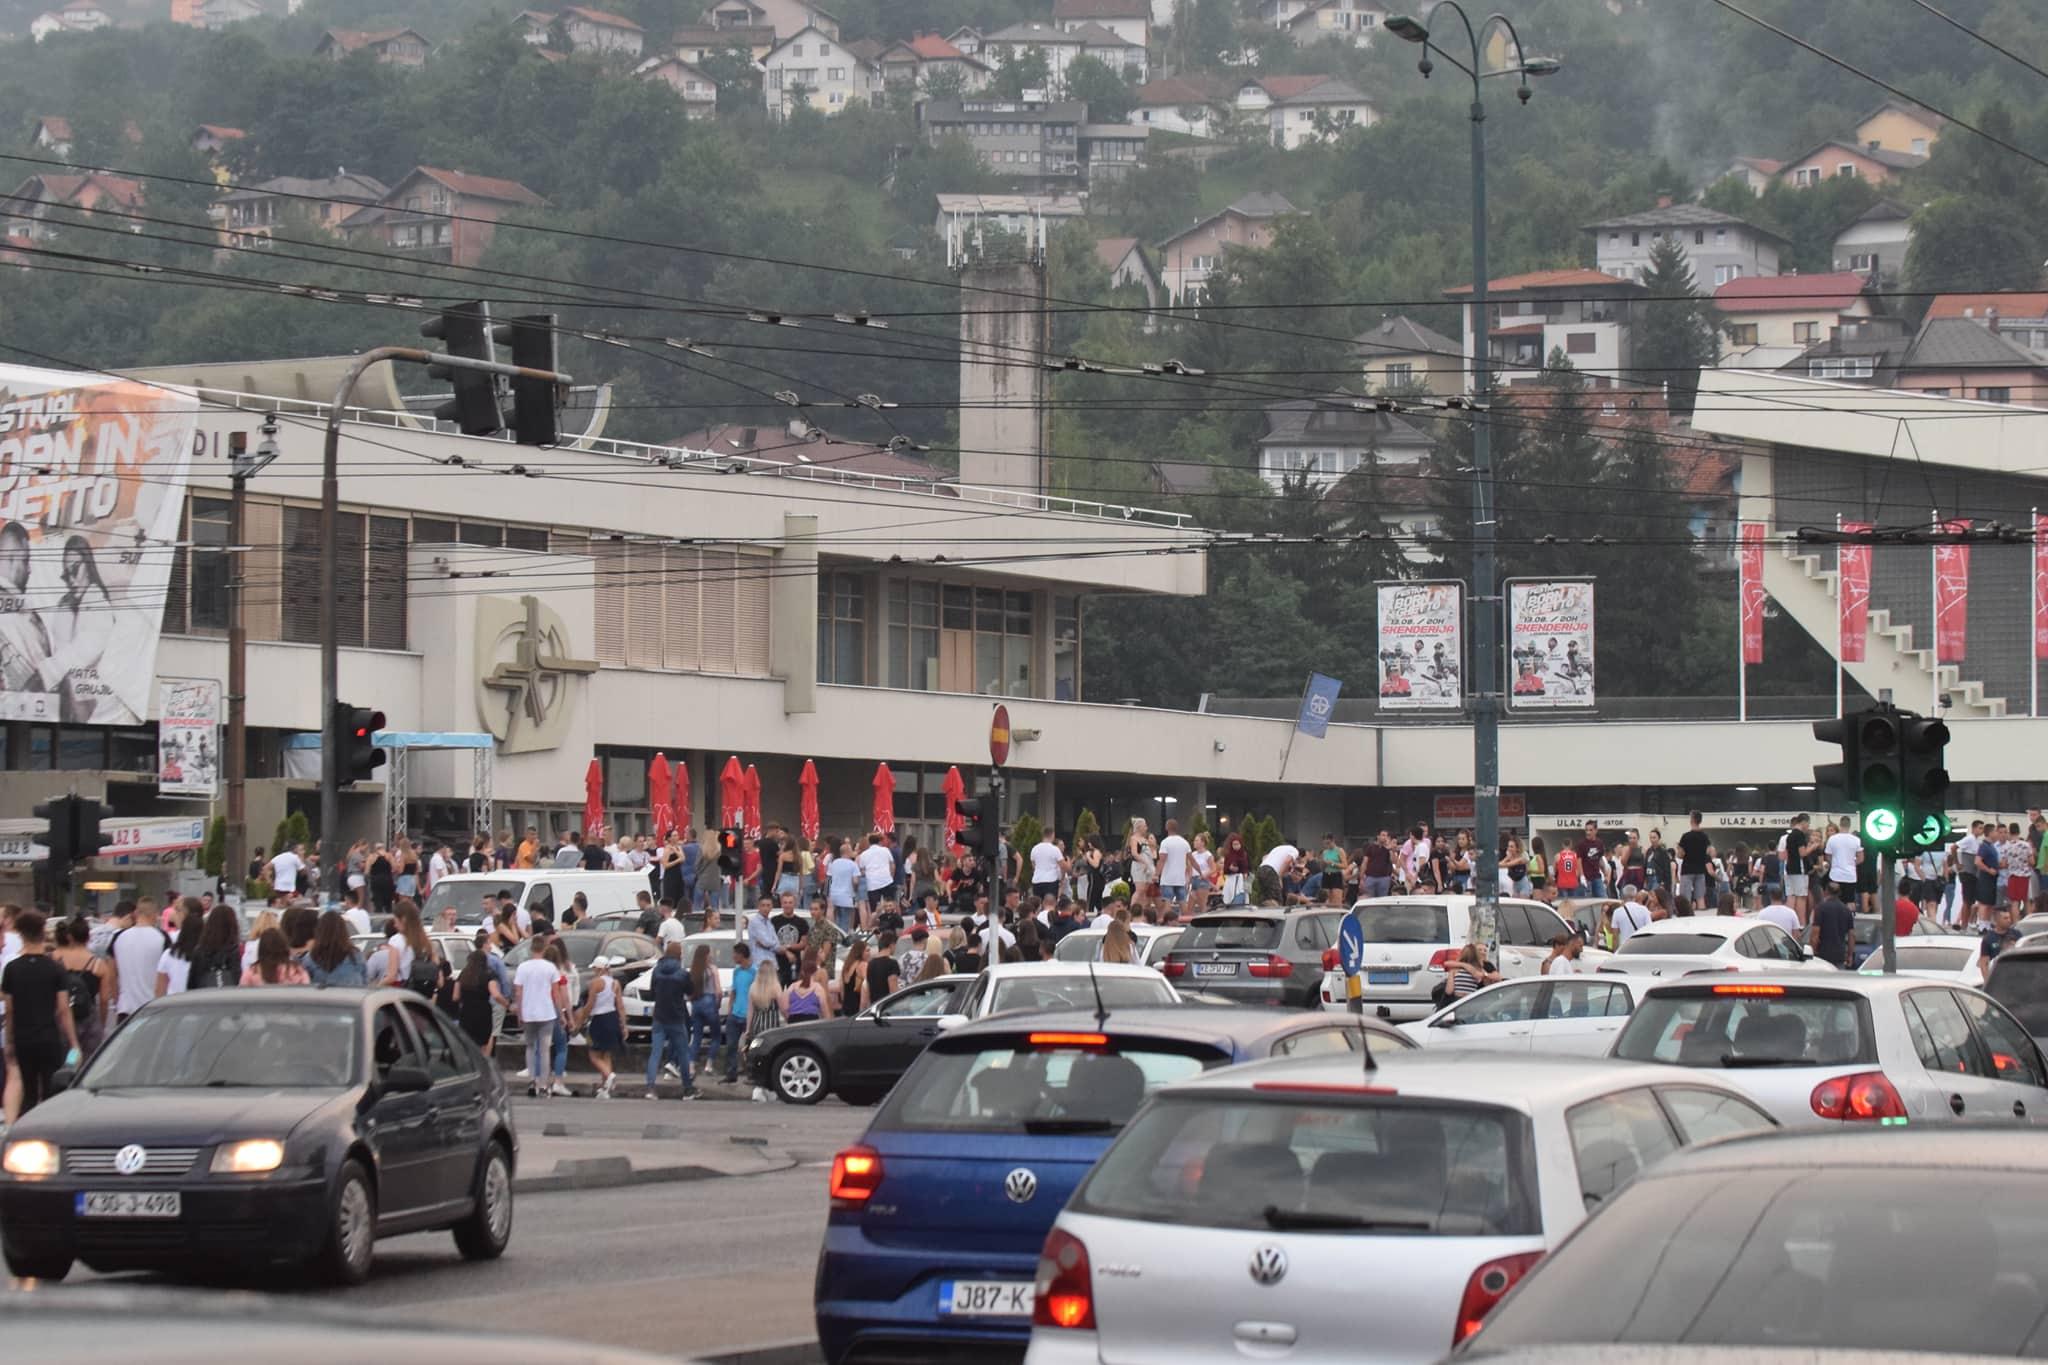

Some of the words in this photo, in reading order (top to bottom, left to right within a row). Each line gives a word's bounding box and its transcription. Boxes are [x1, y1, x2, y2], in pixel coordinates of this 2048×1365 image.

[1381, 625, 1455, 634] SKENDERIJA
[1515, 623, 1589, 633] SKENDERIJA
[1556, 819, 1583, 828] ULAZ
[1720, 817, 1746, 826] ULAZ
[956, 1286, 1035, 1310] J87-K-
